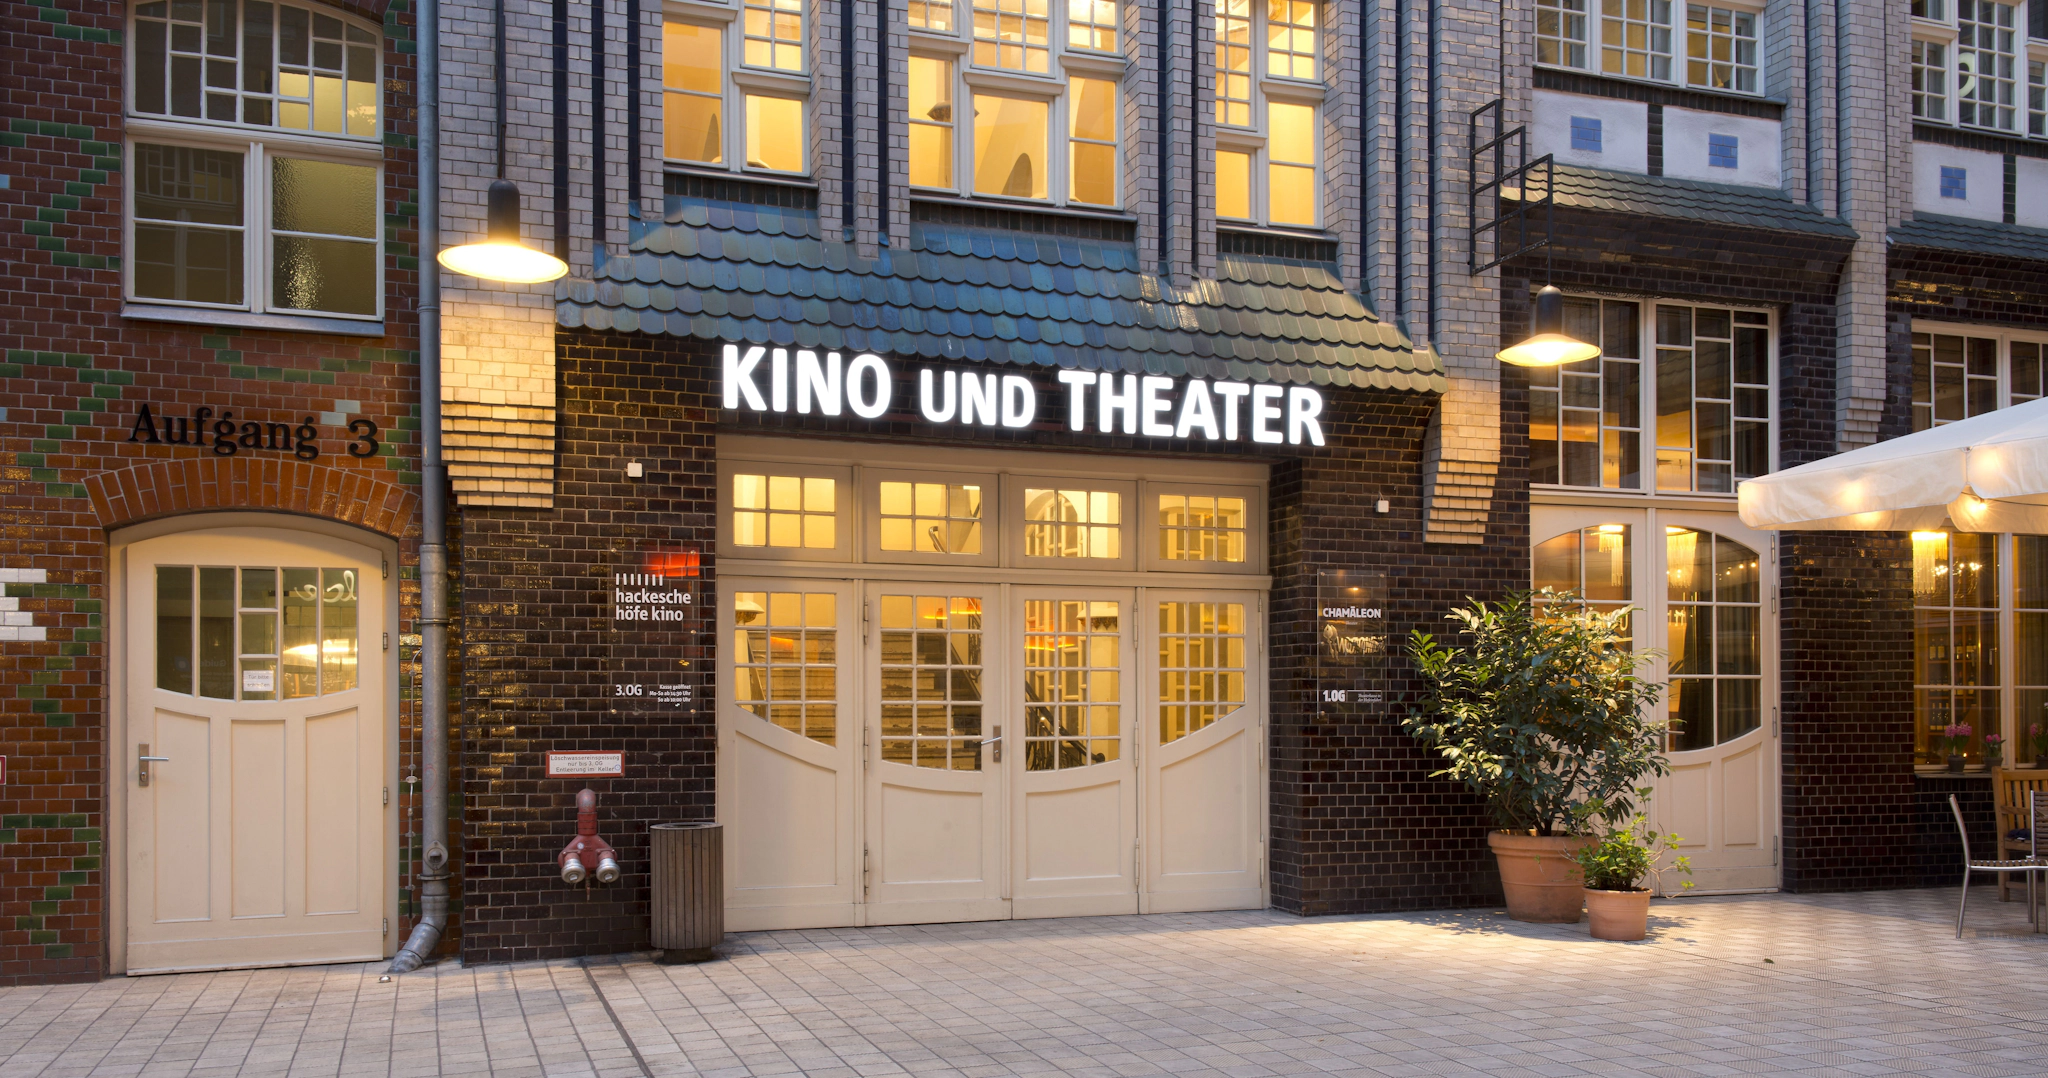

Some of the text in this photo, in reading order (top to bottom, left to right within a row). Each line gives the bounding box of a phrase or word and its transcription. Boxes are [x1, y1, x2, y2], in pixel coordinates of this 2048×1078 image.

[721, 344, 1326, 447] KINO UND THEATER
[128, 403, 380, 461] Aufgang 3
[615, 587, 691, 604] hackesche
[615, 604, 684, 621] höfe kino
[1322, 606, 1382, 618] CHAMÄLEON
[615, 684, 643, 696] 3.OG
[1322, 689, 1346, 702] 1.OG
